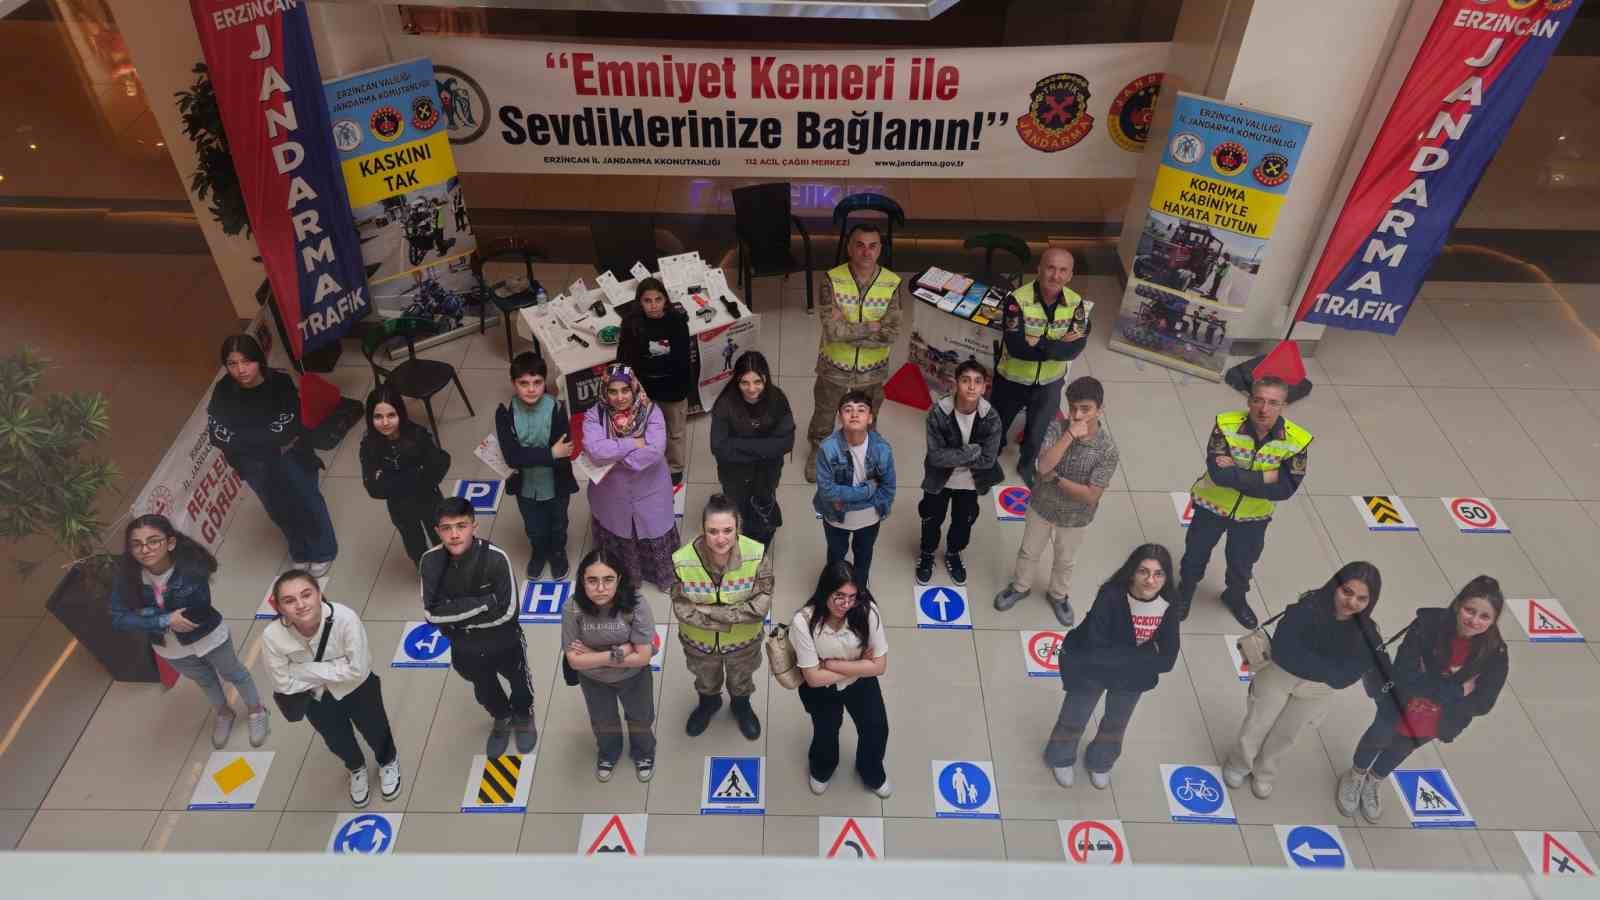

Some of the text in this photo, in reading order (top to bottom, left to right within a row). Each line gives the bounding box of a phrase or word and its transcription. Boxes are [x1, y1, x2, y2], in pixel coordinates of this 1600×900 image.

[213, 0, 298, 30] ERZİNCAN
[1453, 9, 1560, 38] ERZİNCAN
[545, 52, 960, 103] “Emniyet Kemeri ile
[498, 105, 1010, 155] Sevdiklerinize Bağlanın!”
[1019, 119, 1090, 149] JANDARMA
[249, 24, 344, 304] JANDARMA
[359, 143, 432, 177] KASKINI
[603, 157, 652, 165] JANDARMA
[874, 159, 964, 169] www.jandarma.gov.tr
[1347, 38, 1504, 295] JANDARMA
[384, 169, 420, 193] TAK
[1190, 178, 1245, 201] KORUMA
[1163, 200, 1257, 235] HAYATA TUTUN
[1179, 190, 1248, 217] KABİNİYLE
[297, 287, 369, 341] TRAFİK
[1312, 293, 1402, 324] TRAFİK
[464, 483, 491, 502] P
[1460, 506, 1487, 520] 50
[528, 583, 564, 613] H
